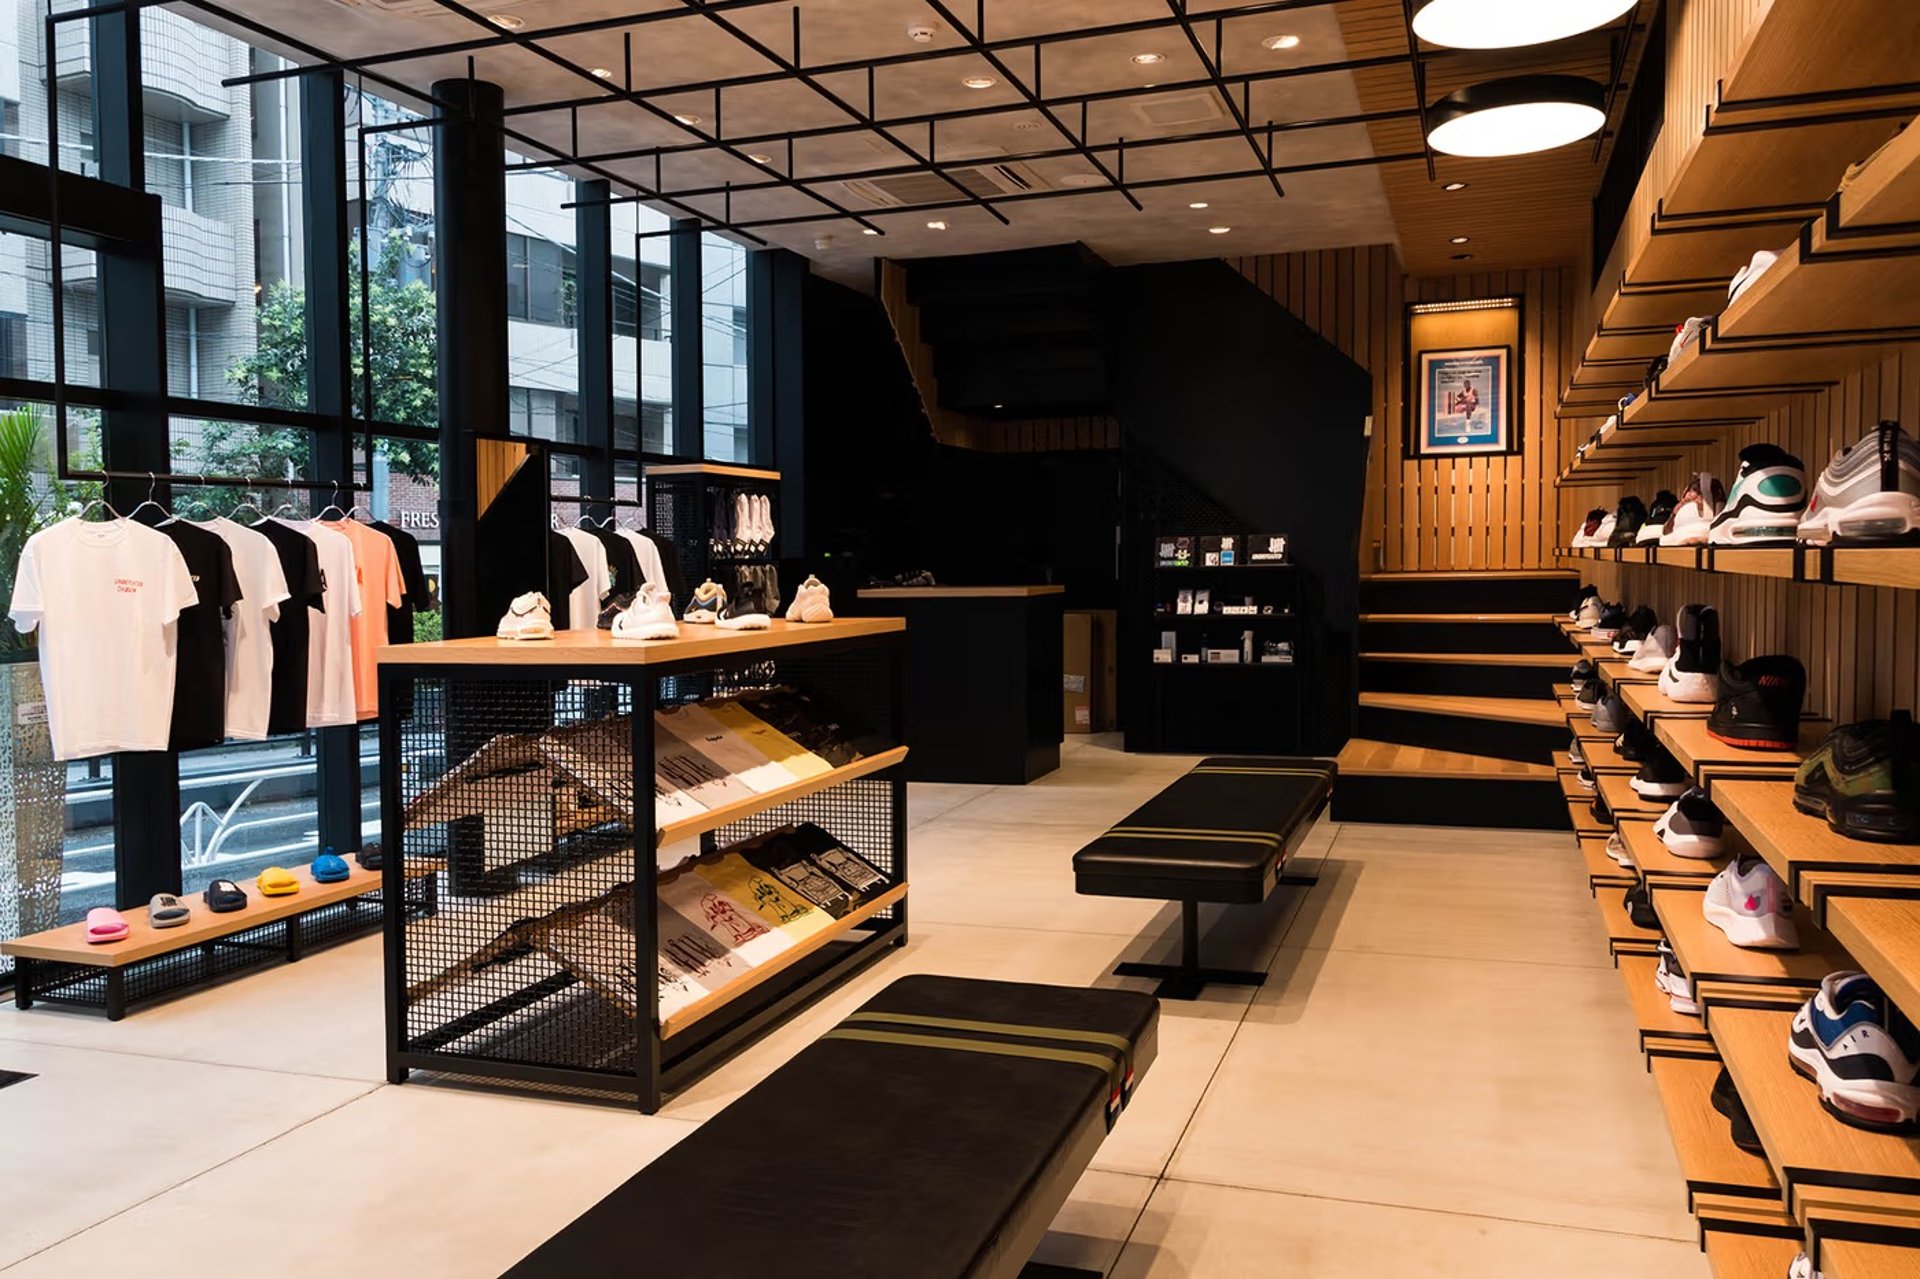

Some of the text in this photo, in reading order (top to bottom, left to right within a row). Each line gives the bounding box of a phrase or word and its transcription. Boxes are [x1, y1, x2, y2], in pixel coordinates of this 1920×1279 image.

[401, 511, 440, 528] FRES
[1758, 674, 1785, 686] NIK
[1843, 1030, 1870, 1050] AIR
